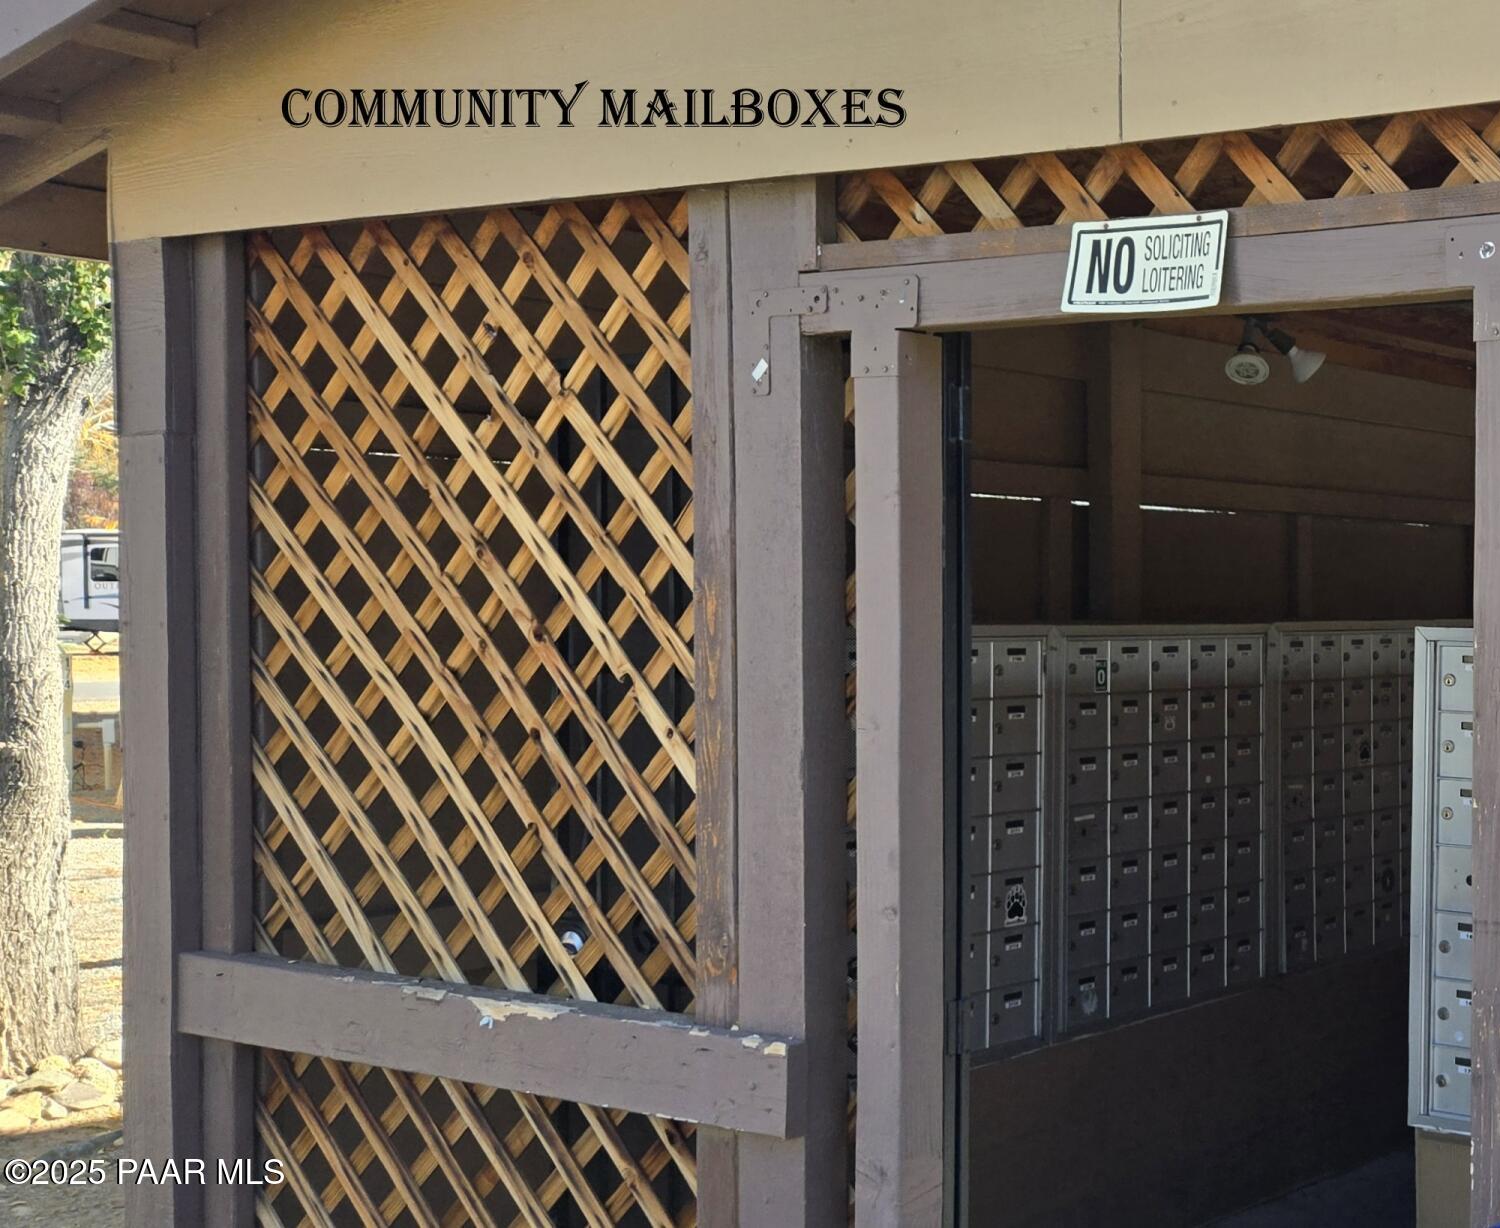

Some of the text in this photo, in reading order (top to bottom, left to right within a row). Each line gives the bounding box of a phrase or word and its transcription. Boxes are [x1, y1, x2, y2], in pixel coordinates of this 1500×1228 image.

[1144, 230, 1211, 261] SOLICITING
[1085, 236, 1136, 295] NO
[1142, 263, 1204, 293] LOITERING
